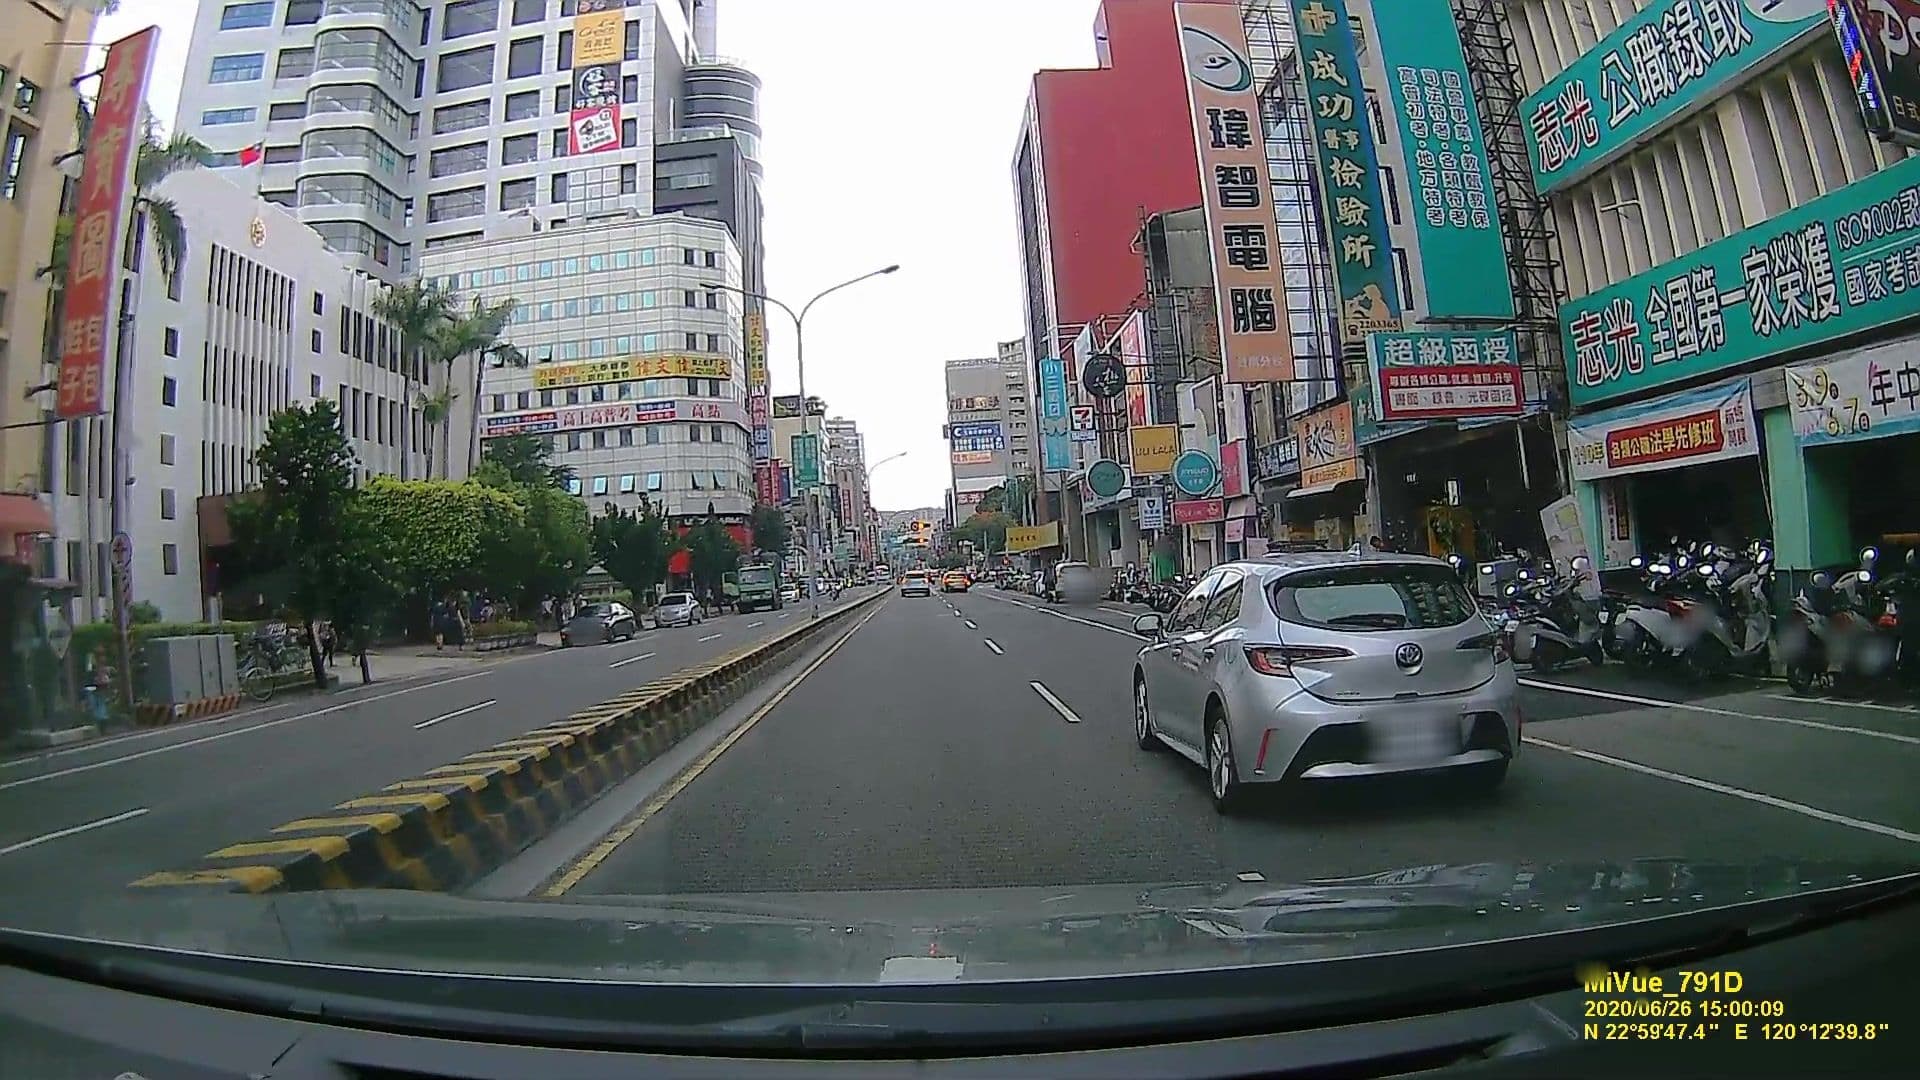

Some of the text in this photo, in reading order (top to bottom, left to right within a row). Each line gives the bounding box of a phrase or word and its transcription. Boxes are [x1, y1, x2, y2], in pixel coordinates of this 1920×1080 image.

[1530, 80, 1599, 174] 志光
[1601, 0, 1752, 129] 公職錄取
[1384, 337, 1512, 367] 超級函授
[1570, 222, 1841, 387] 志光 全國第一家榮獲
